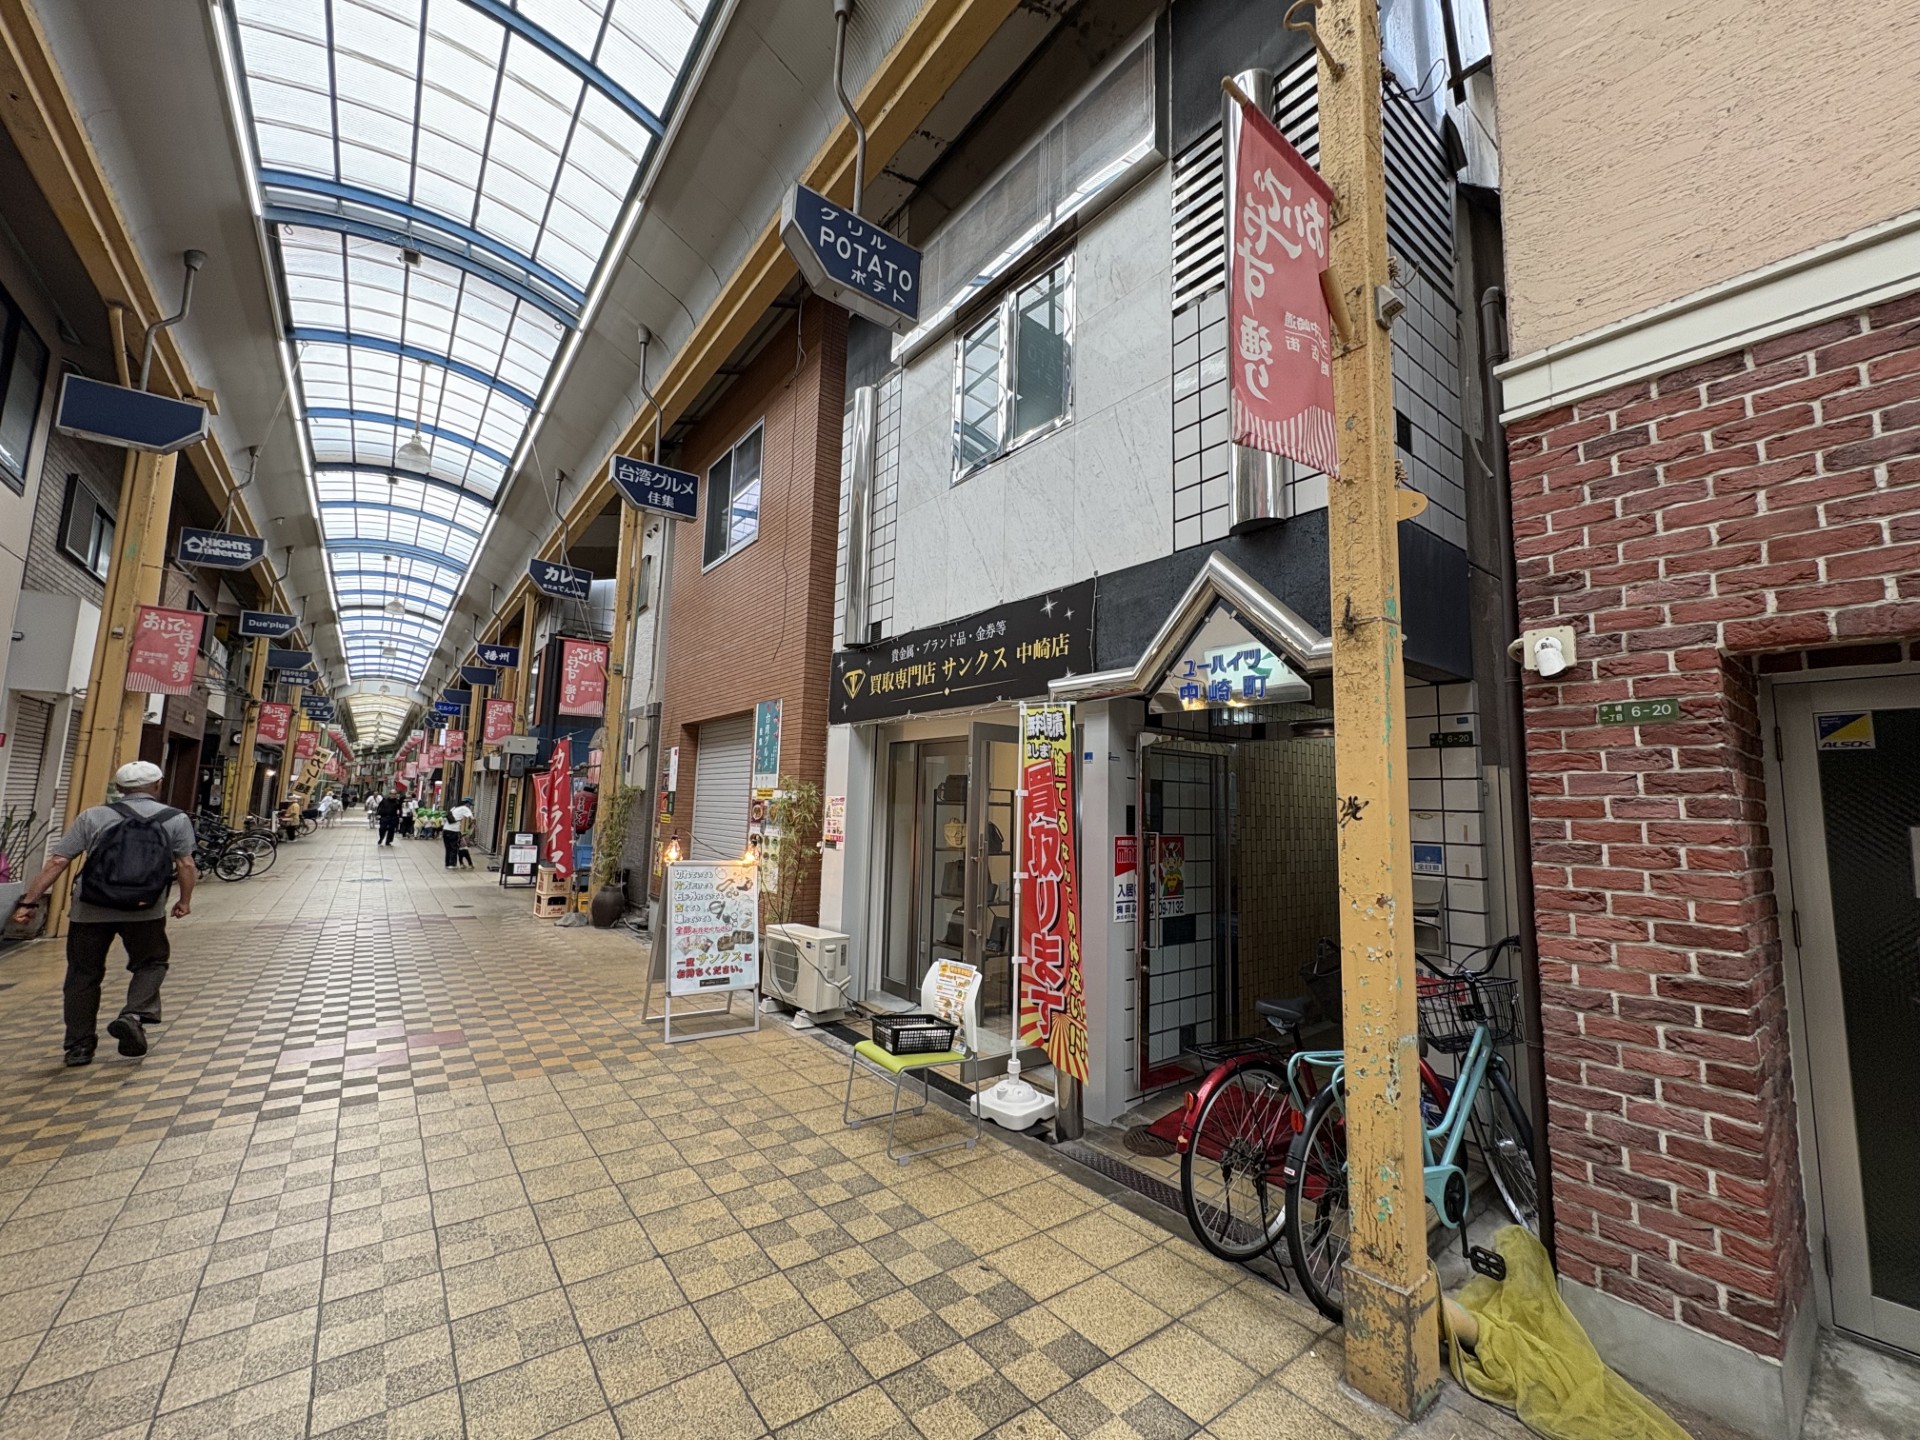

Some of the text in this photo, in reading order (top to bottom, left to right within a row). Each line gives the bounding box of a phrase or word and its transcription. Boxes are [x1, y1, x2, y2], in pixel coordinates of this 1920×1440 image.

[820, 207, 887, 250] グリル
[819, 225, 913, 292] POTATO
[850, 269, 905, 304] ポテト
[618, 463, 694, 495] 台湾グルメ
[647, 490, 675, 509] 佳集
[202, 536, 252, 552] HIGHTS
[203, 546, 253, 561] interact
[544, 566, 588, 584] カレー
[484, 649, 511, 663] 播州
[869, 633, 1070, 697] 買取専門店 サンクス 中崎店
[1182, 648, 1262, 679] ユーハイツ
[1179, 675, 1267, 705] 中崎町
[1631, 703, 1672, 718] 6-20
[1447, 734, 1470, 743] 6-20
[1822, 740, 1872, 749] ALSOK
[546, 747, 568, 875] カレーライス
